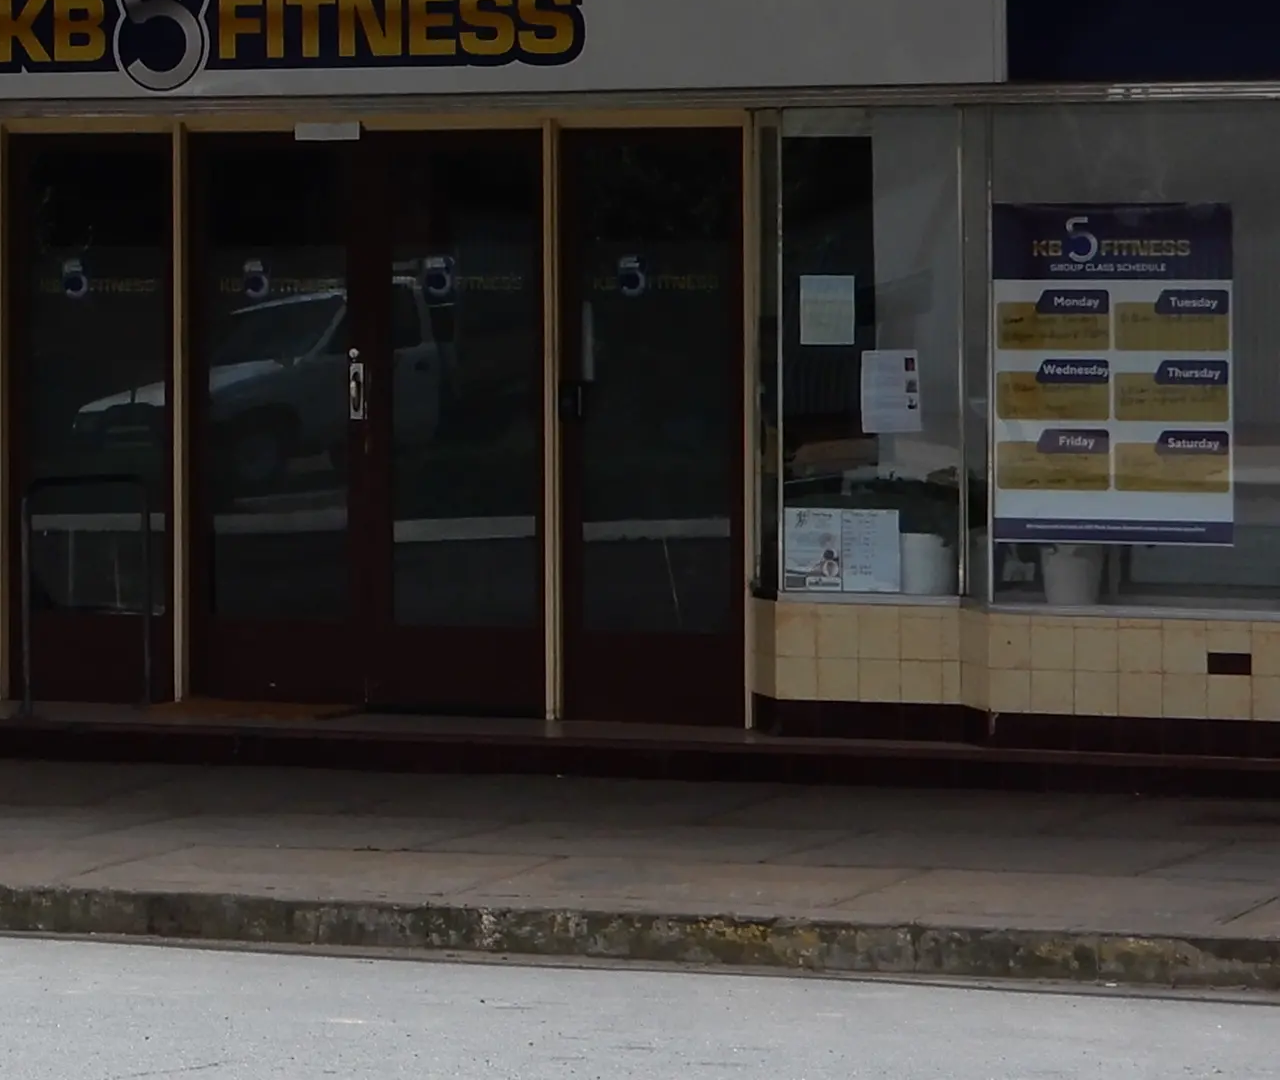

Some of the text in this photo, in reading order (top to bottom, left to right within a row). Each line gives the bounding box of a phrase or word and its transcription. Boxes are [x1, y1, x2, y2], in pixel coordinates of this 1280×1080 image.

[1100, 239, 1192, 257] FITNESS
[1053, 295, 1100, 309] Monday
[1169, 296, 1219, 309] Tuesday
[1042, 364, 1110, 378] Wednesday
[1167, 367, 1221, 381] Thursday
[1057, 435, 1096, 449] Friday
[1167, 437, 1220, 451] Saturday
